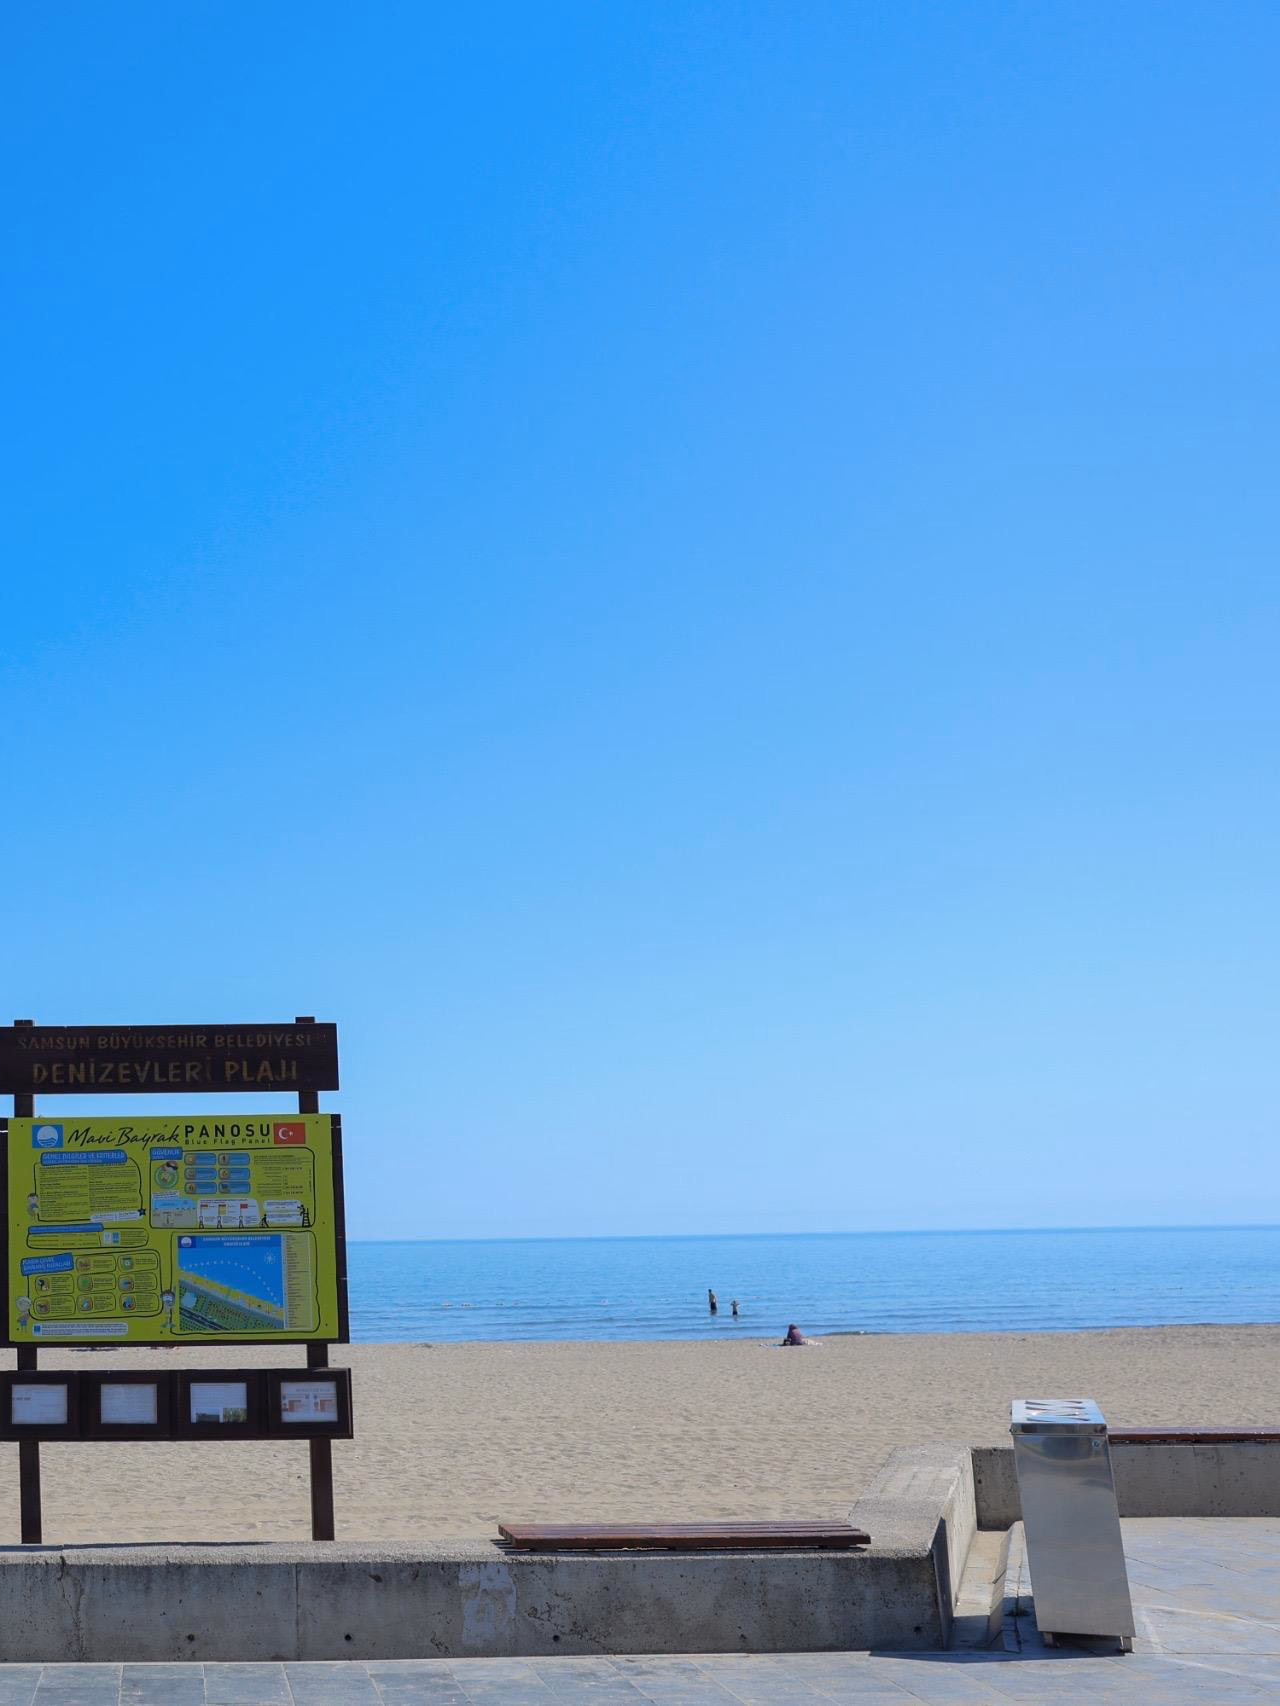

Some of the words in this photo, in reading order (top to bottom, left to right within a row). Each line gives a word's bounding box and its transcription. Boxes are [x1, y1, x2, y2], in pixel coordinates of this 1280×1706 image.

[224, 1058, 297, 1081] PLAJI
[68, 1127, 115, 1147] Mavi
[114, 1125, 180, 1150] Bayrak
[185, 1124, 270, 1138] PANOSU
